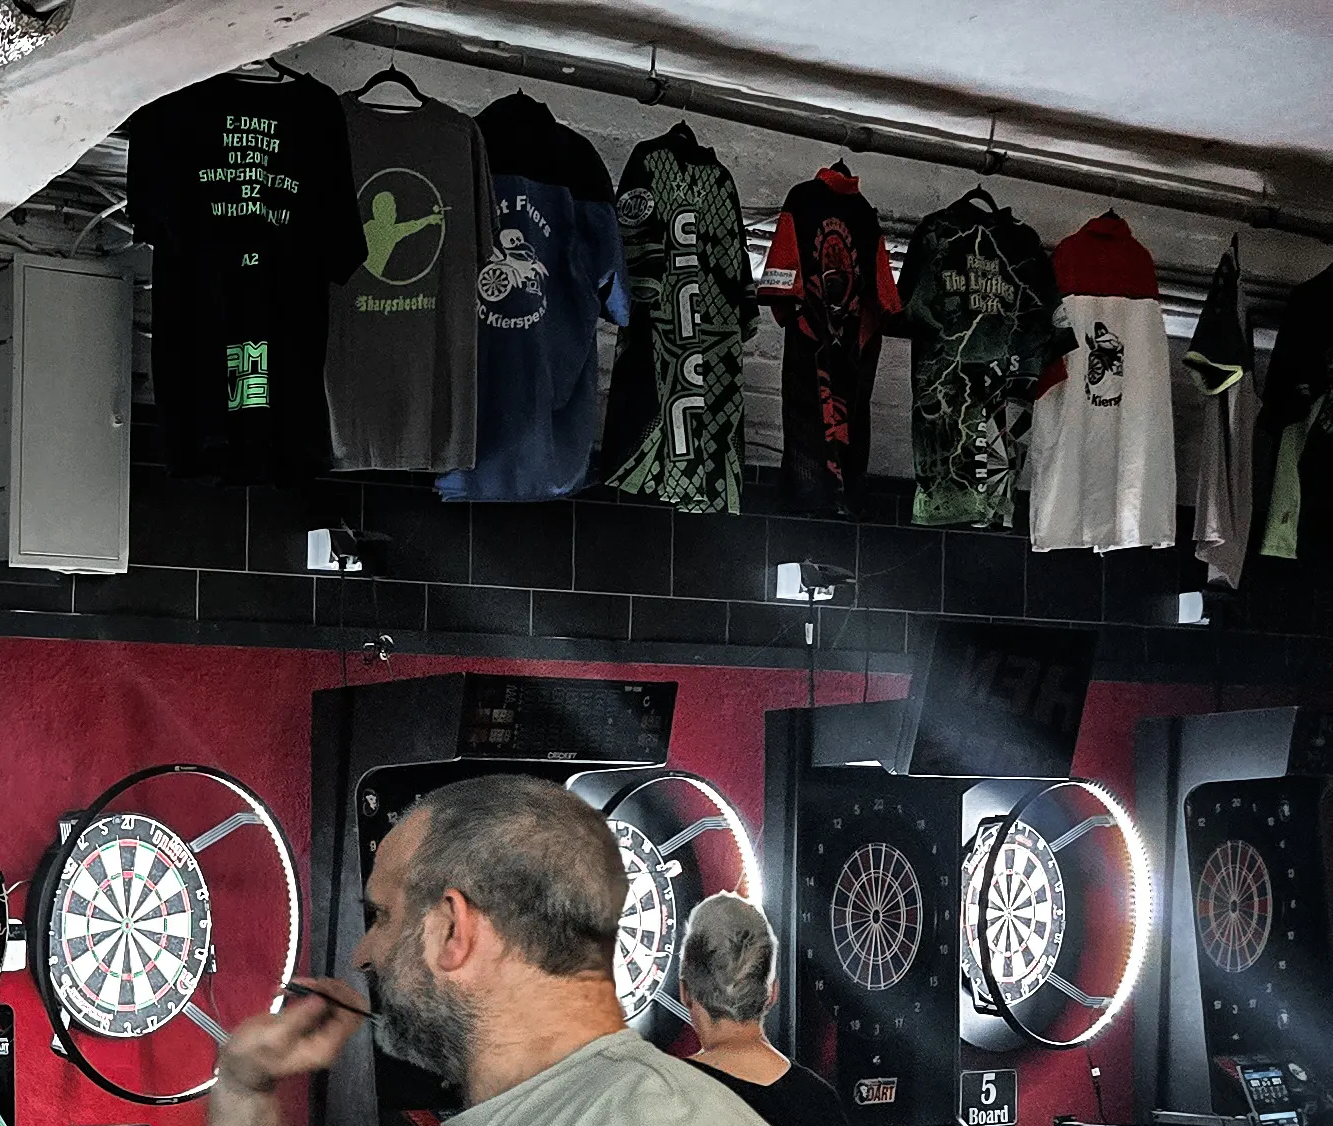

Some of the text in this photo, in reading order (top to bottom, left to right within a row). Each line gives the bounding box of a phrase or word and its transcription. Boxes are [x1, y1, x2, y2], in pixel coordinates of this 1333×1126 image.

[226, 115, 278, 134] E-DART
[223, 133, 280, 153] MEISTER
[241, 184, 261, 198] BZ
[241, 253, 259, 266] A2
[487, 311, 540, 330] Kierspe
[980, 1072, 997, 1105] 5
[968, 1105, 1009, 1125] Board
